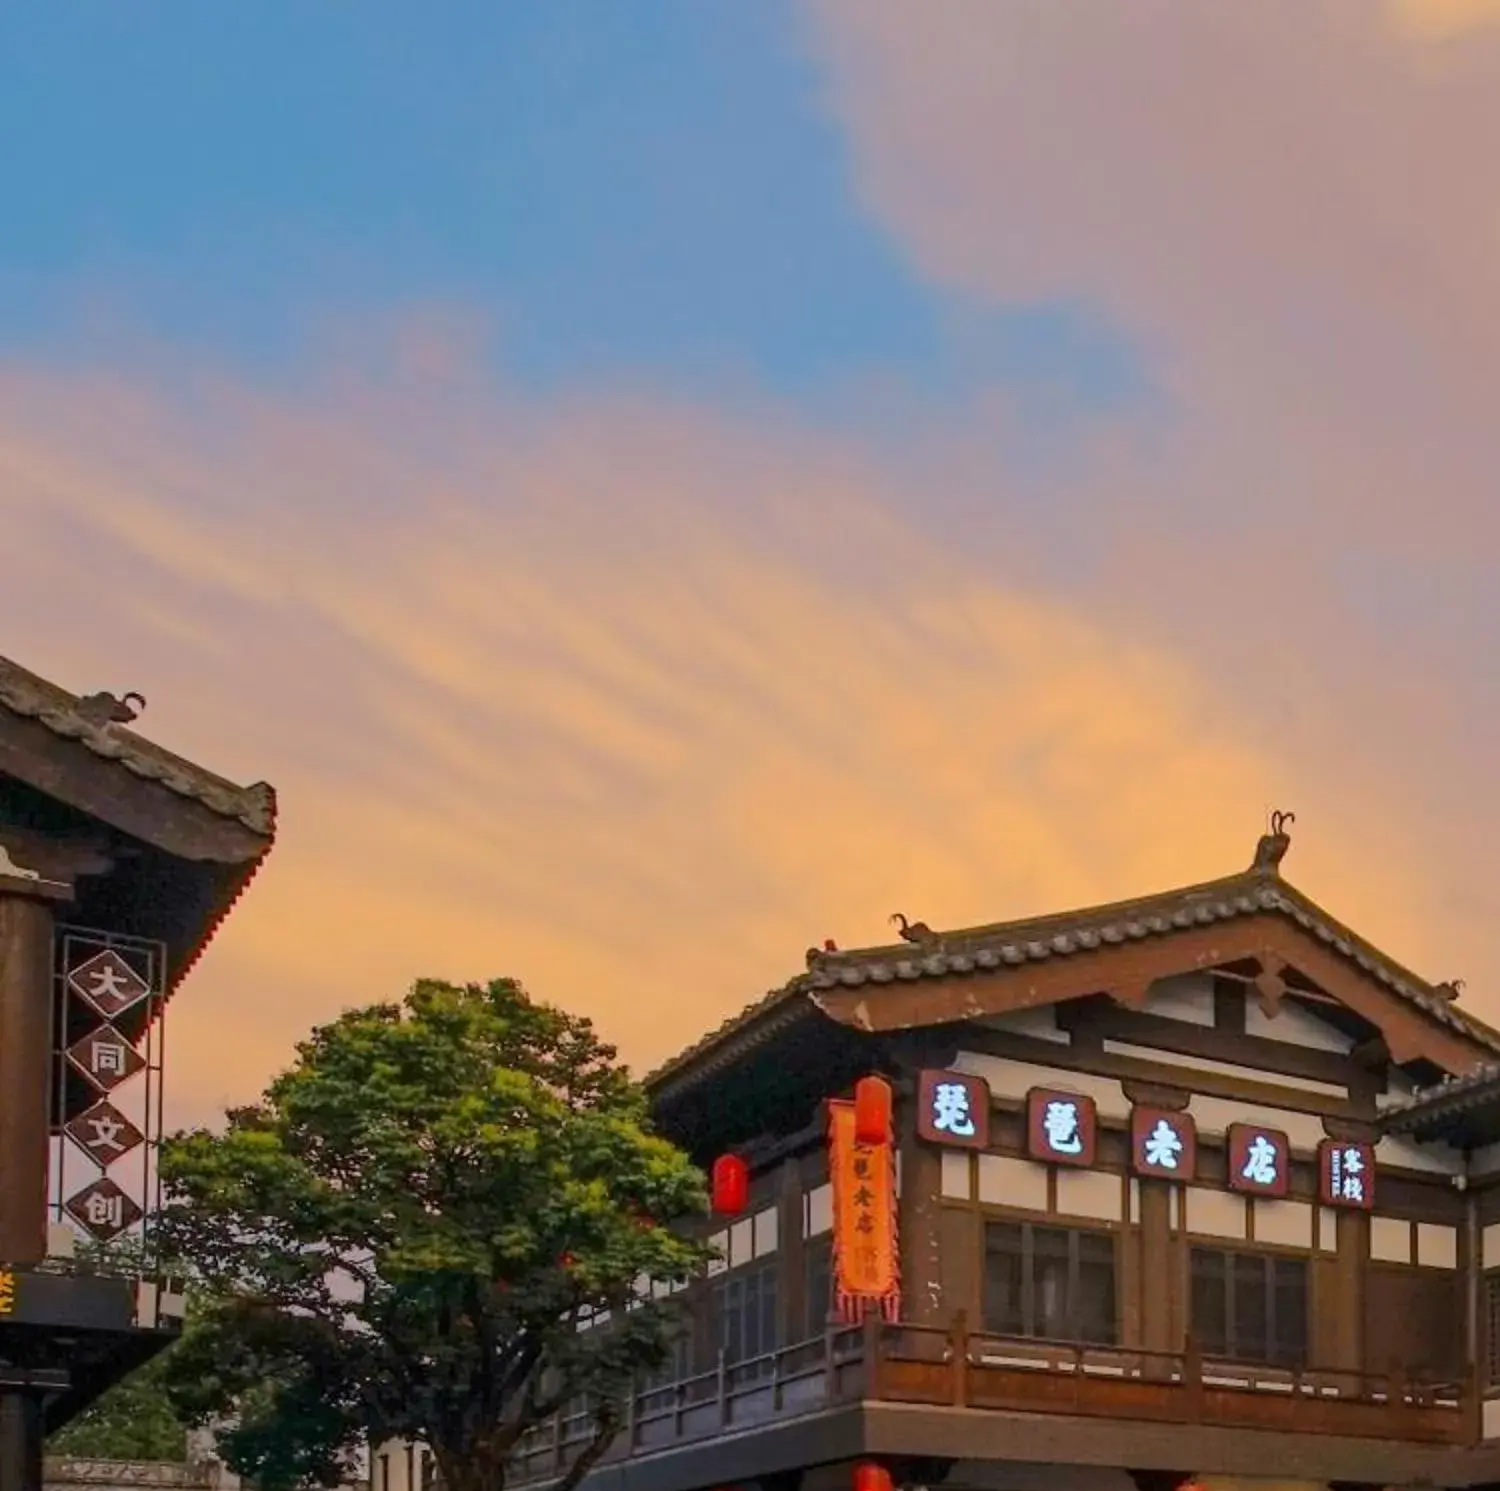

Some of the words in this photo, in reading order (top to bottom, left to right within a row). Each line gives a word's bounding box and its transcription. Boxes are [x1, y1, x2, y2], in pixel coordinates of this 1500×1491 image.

[85, 964, 128, 1227] 大同文创
[930, 1082, 1279, 1186] 琵琶老店
[1342, 1147, 1366, 1203] 客栈
